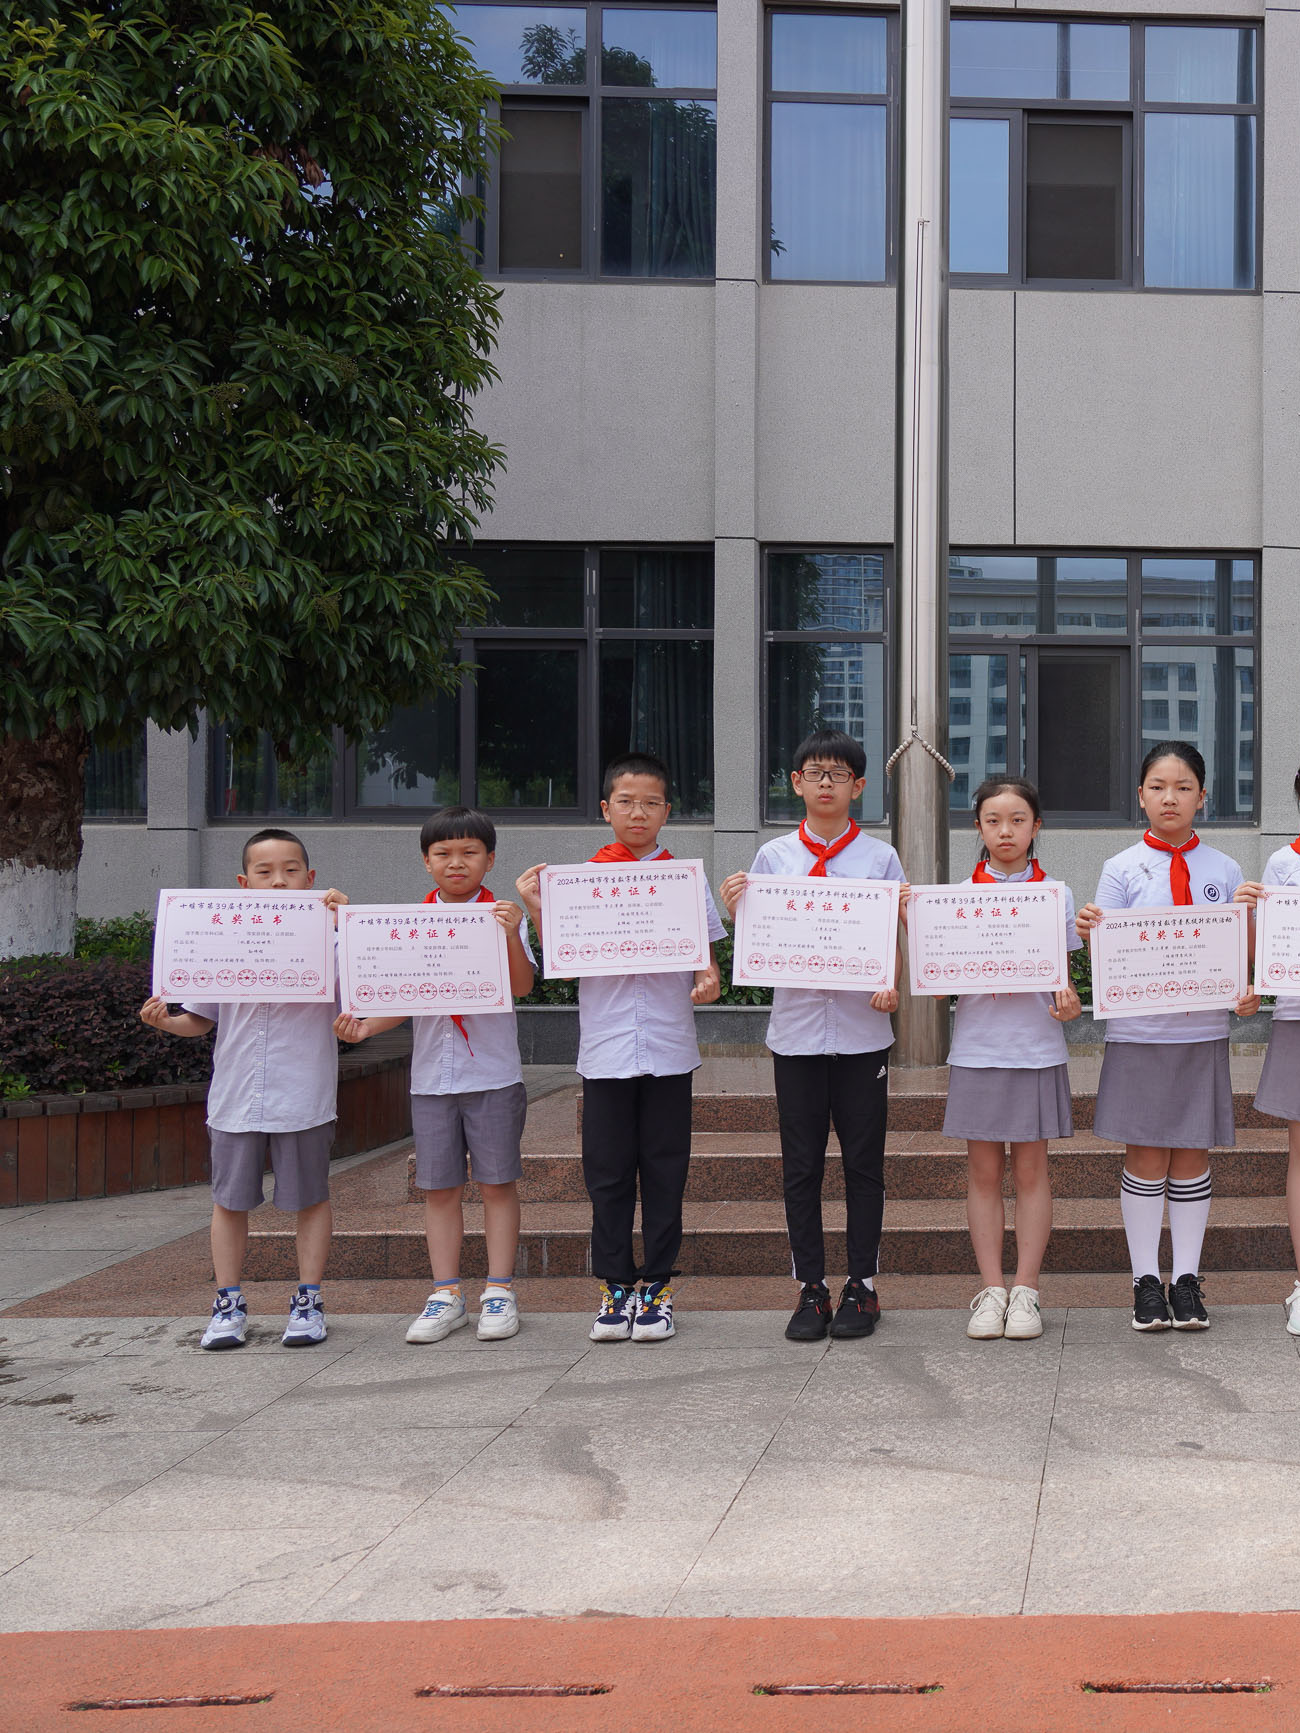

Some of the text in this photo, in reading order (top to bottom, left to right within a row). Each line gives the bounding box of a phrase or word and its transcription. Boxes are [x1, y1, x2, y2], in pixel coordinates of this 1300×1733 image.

[592, 885, 658, 899] 获奖证书
[786, 899, 851, 913] 获奖证书
[956, 907, 1020, 919] 获奖证书
[211, 914, 285, 925] 获奖证书
[389, 928, 457, 940] 获奖证书
[1139, 929, 1202, 942] 获奖证书
